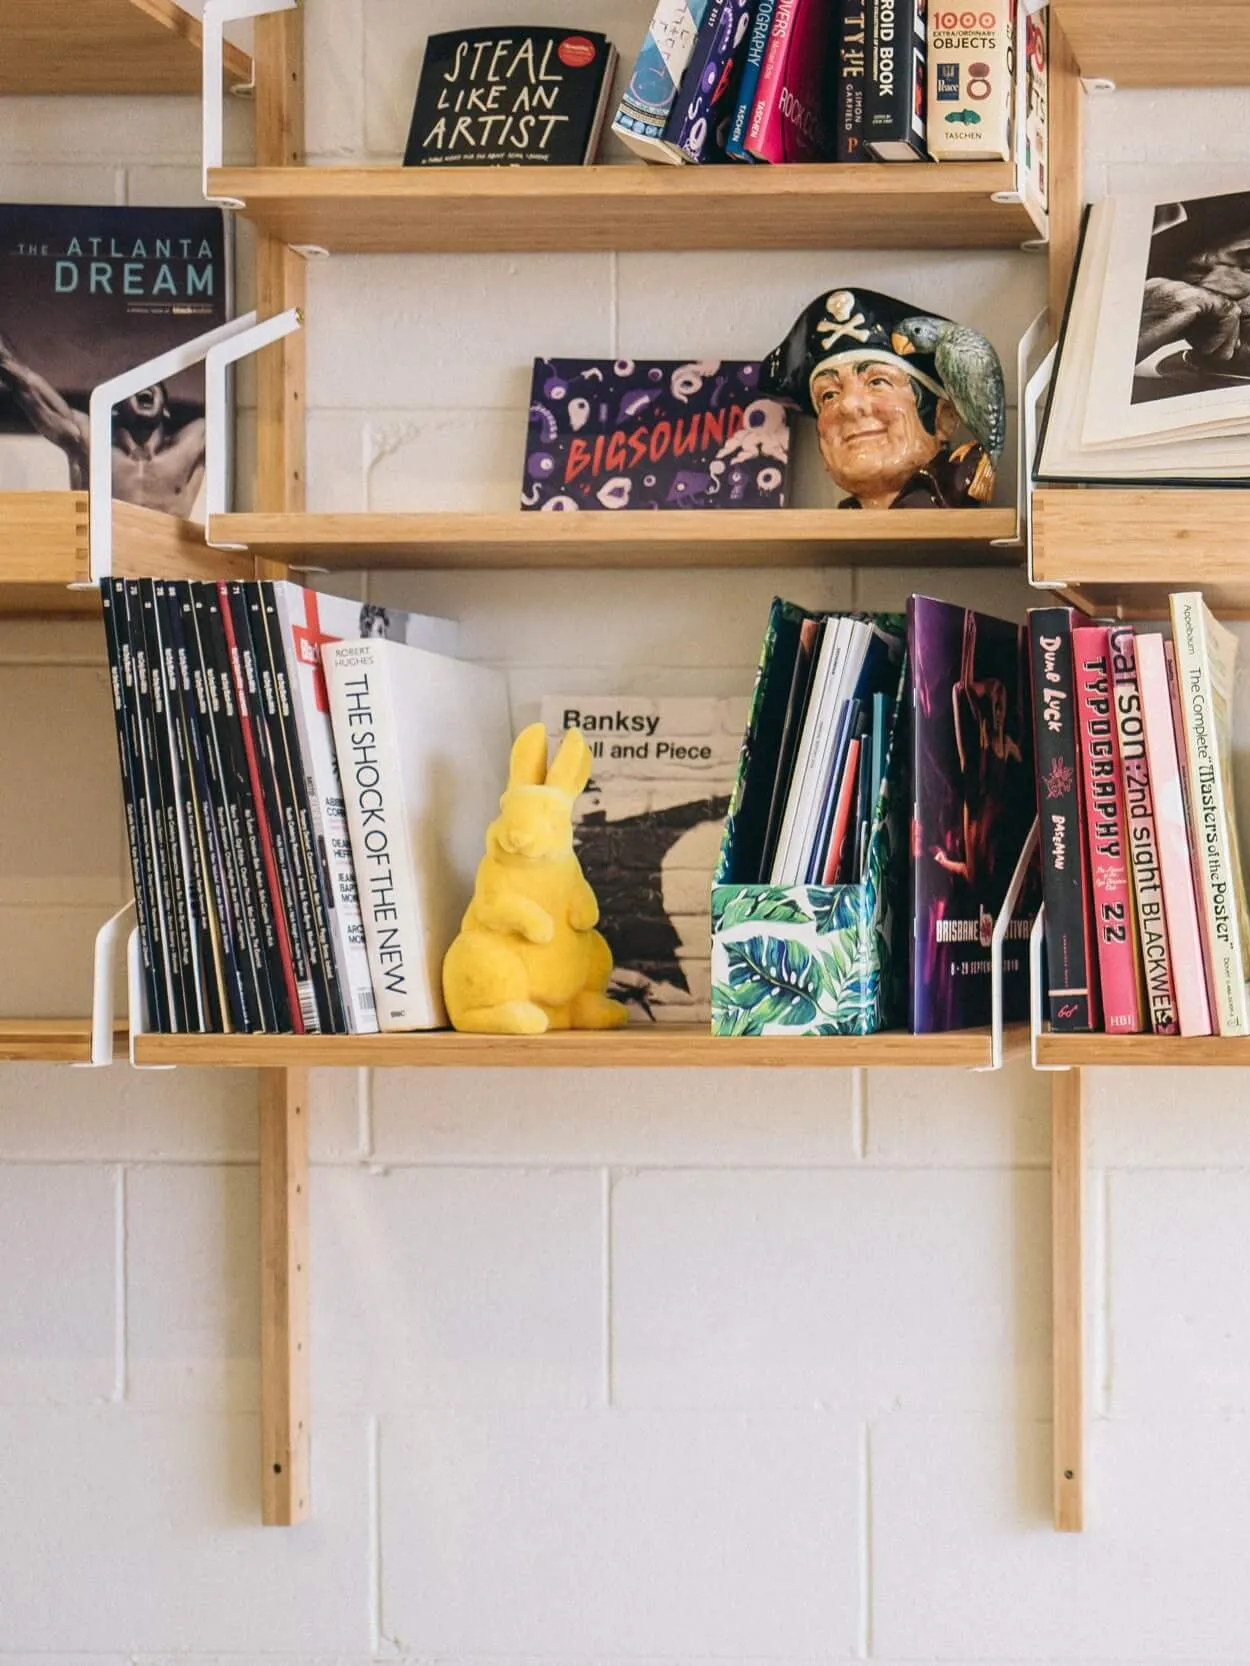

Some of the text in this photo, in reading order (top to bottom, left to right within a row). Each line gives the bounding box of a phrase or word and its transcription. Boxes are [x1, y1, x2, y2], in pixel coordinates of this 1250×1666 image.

[708, 8, 719, 27] 2017
[934, 12, 996, 30] 1000
[443, 37, 564, 84] STEAL
[933, 38, 996, 49] OBJECTS
[879, 47, 894, 96] BOOK
[437, 85, 560, 113] LIKE AN
[845, 83, 854, 131] GARFIELD
[855, 91, 863, 123] SIMON
[422, 115, 569, 150] ARTIST
[732, 104, 747, 142] TASCHEN
[750, 100, 766, 138] TASCHEN
[945, 132, 982, 140] TASCHEN
[18, 237, 213, 258] THE ATLANTA
[55, 261, 214, 296] DREAM
[565, 404, 744, 484] BIGSOUND
[1183, 603, 1196, 656] Appelbaum
[335, 647, 370, 657] ROBERT
[335, 656, 374, 667] HUGHES
[1189, 667, 1201, 693] The
[344, 673, 373, 727] THE
[562, 709, 660, 736] Banksy
[1193, 694, 1208, 759] Complete
[589, 742, 712, 759] ll and Piece
[351, 731, 386, 827] SHOCK
[1083, 655, 1121, 859] TYPOGRAPHY
[1102, 902, 1128, 945] 22
[364, 830, 391, 866] OF
[1133, 826, 1159, 893] sight
[1209, 846, 1220, 858] of
[1209, 858, 1220, 881] the
[369, 870, 398, 922] THE
[936, 919, 979, 944] BRISBANE
[377, 927, 407, 995] NEW
[970, 960, 992, 975] SEPTEM
